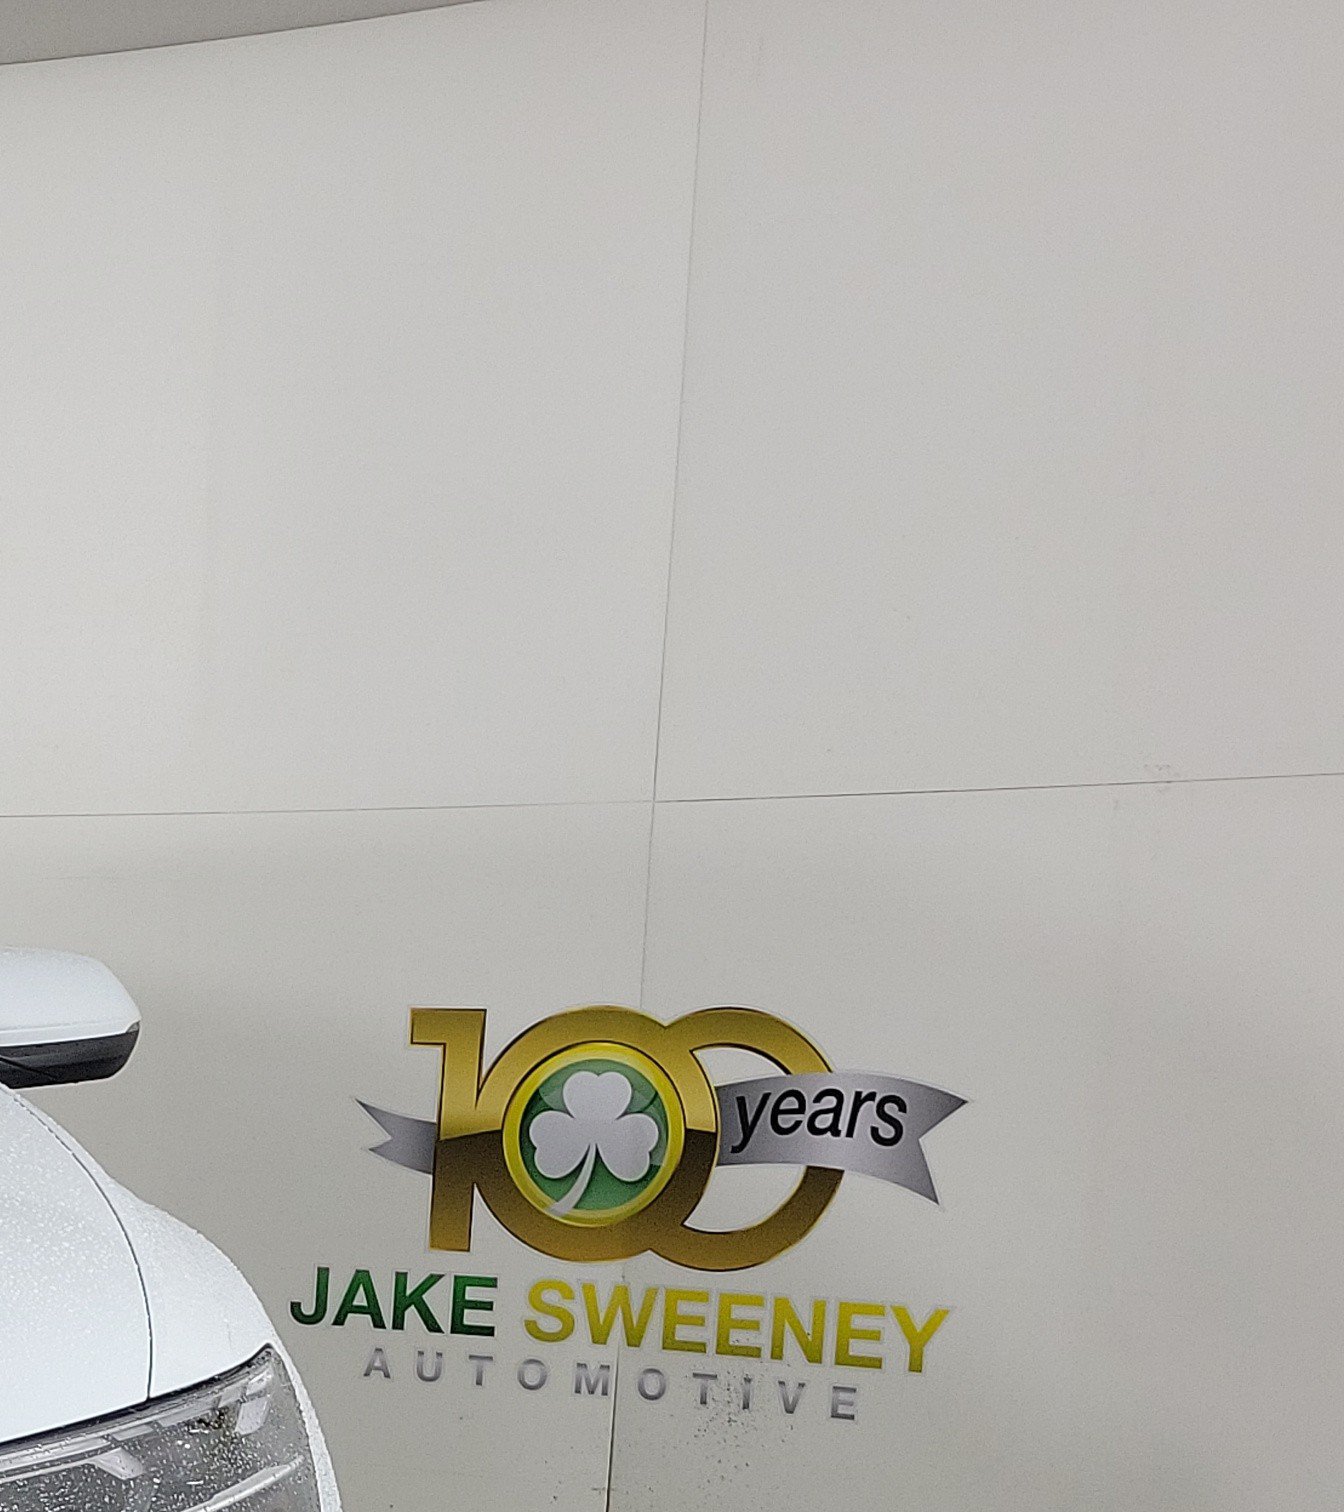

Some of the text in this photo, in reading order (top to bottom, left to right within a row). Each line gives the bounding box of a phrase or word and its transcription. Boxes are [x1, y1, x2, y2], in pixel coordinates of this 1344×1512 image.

[410, 1005, 907, 1271] 100 years
[290, 1266, 950, 1374] JAKE SWEENEY
[364, 1347, 857, 1421] AUTOMOTIVE
